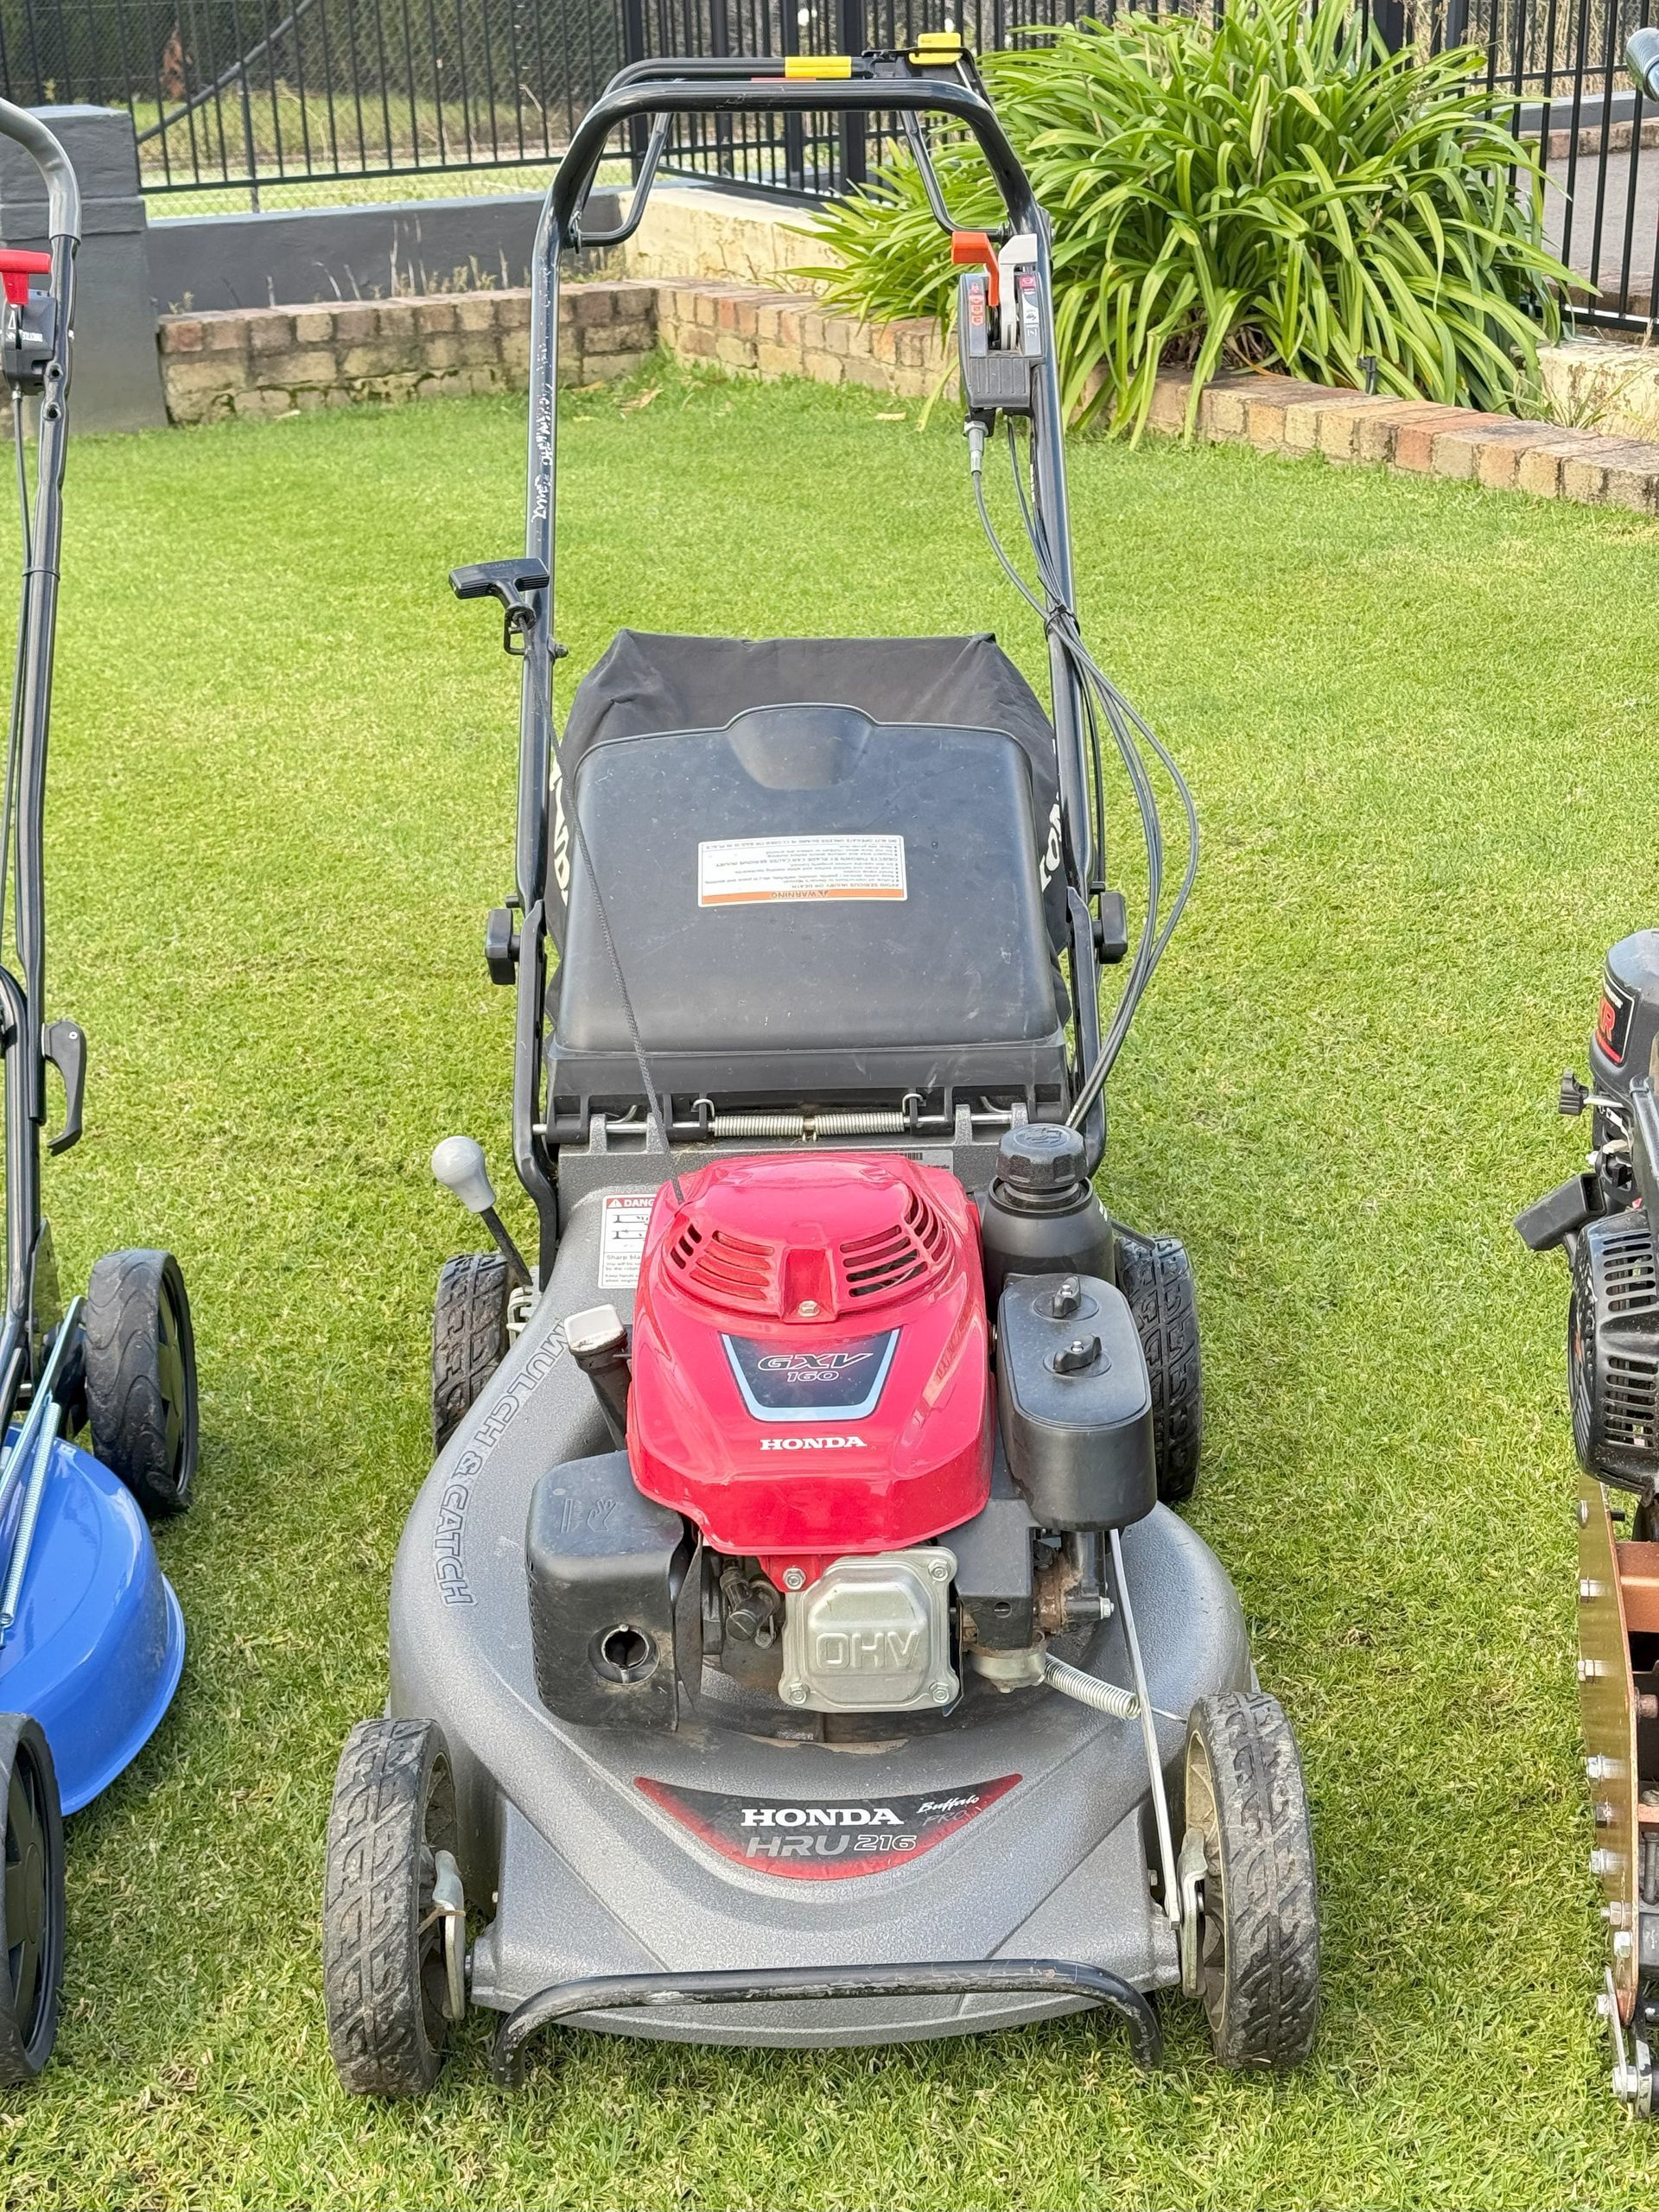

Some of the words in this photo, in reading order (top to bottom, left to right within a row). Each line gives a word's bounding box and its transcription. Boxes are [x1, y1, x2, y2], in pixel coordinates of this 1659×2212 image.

[623, 1198, 654, 1207] DANG
[758, 1352, 874, 1371] GXV
[474, 1323, 570, 1447] MULCH
[787, 1370, 839, 1382] 160
[760, 1436, 868, 1450] HONDA
[451, 1451, 482, 1479] &
[435, 1484, 473, 1605] CATCH
[817, 1630, 920, 1669] OHV
[916, 1794, 980, 1814] Buffalo
[741, 1808, 905, 1827] HONDA
[922, 1809, 967, 1826] PRO
[746, 1834, 851, 1858] HRU
[854, 1834, 917, 1852] 216
